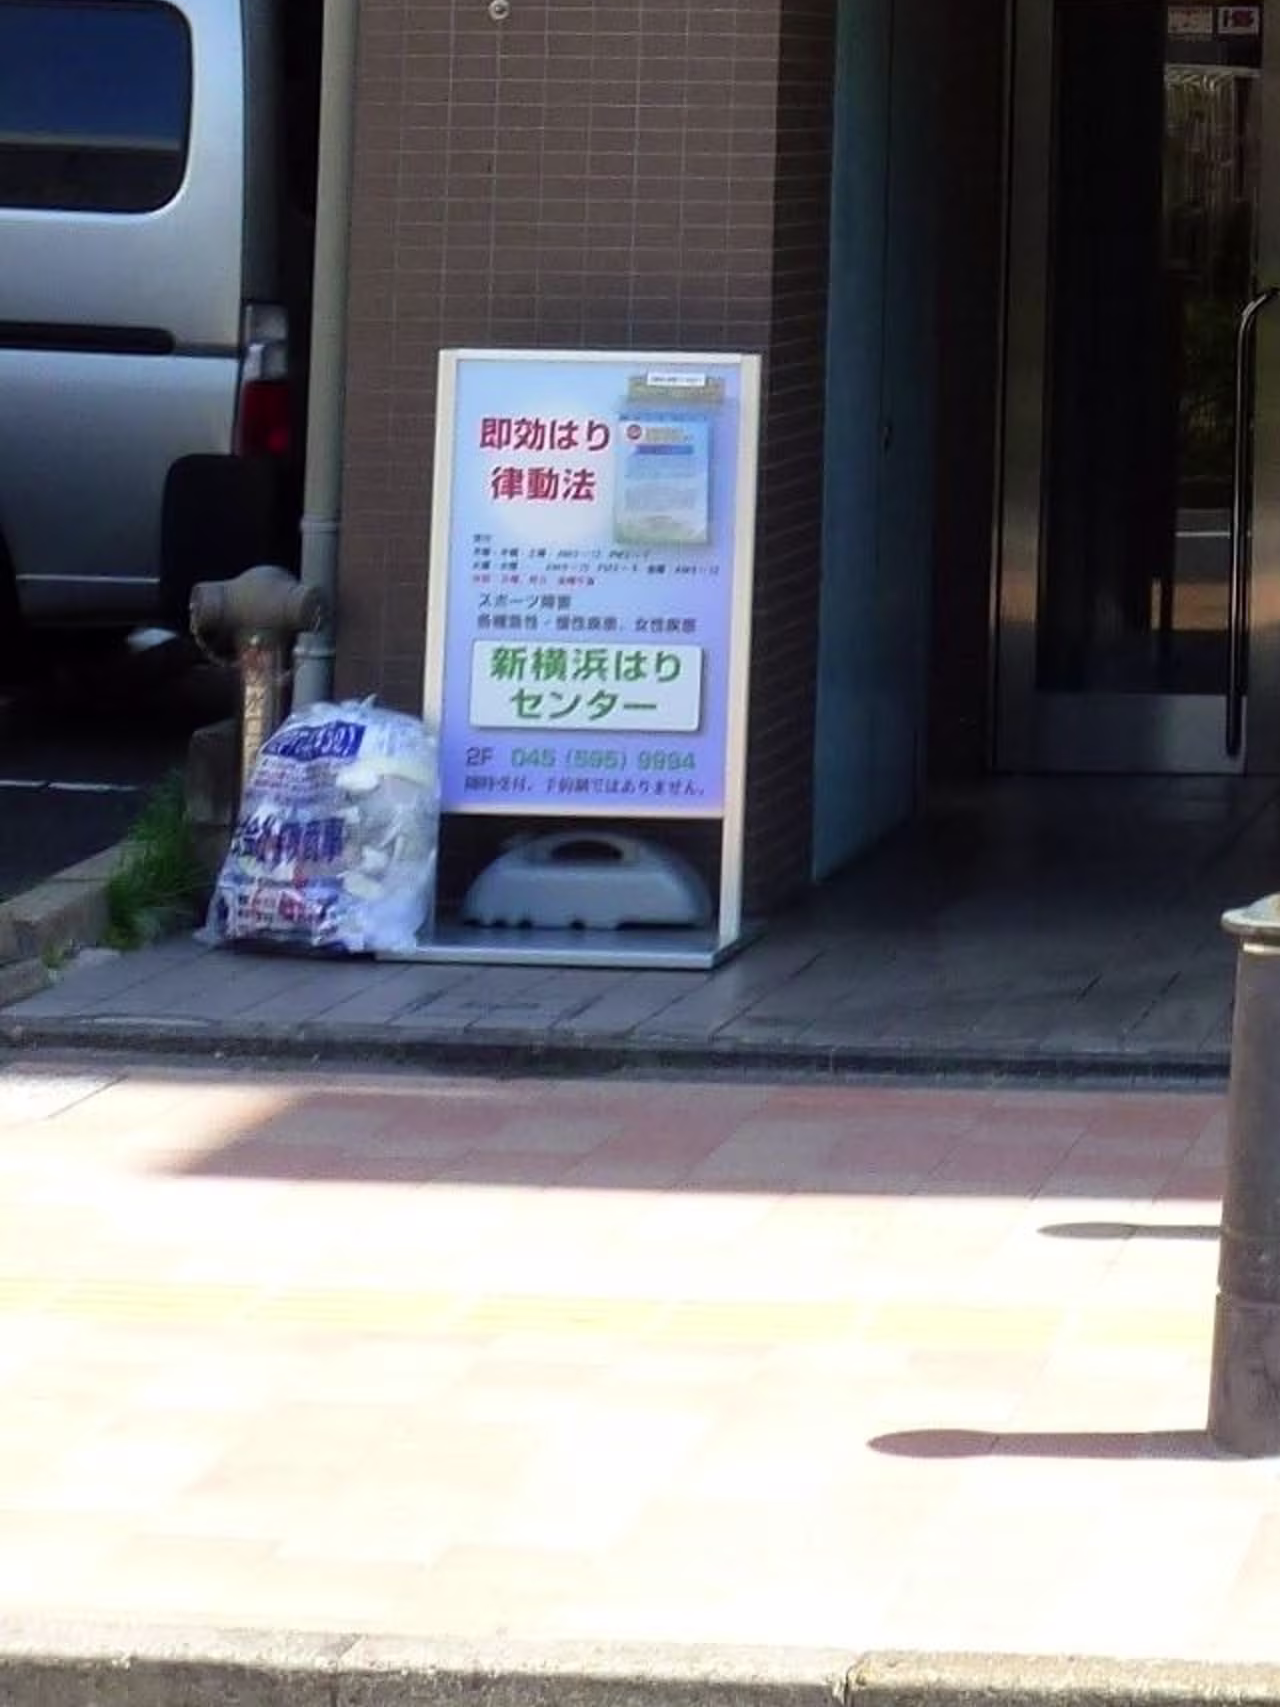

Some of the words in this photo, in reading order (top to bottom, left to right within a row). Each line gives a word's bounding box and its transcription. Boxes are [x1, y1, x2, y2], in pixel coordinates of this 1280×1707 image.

[479, 416, 612, 452] 即効はり
[490, 465, 597, 501] 律動法
[489, 646, 682, 683] 新横浜はり
[510, 687, 658, 721] センター
[465, 746, 494, 768] 2F
[510, 748, 556, 769] 045
